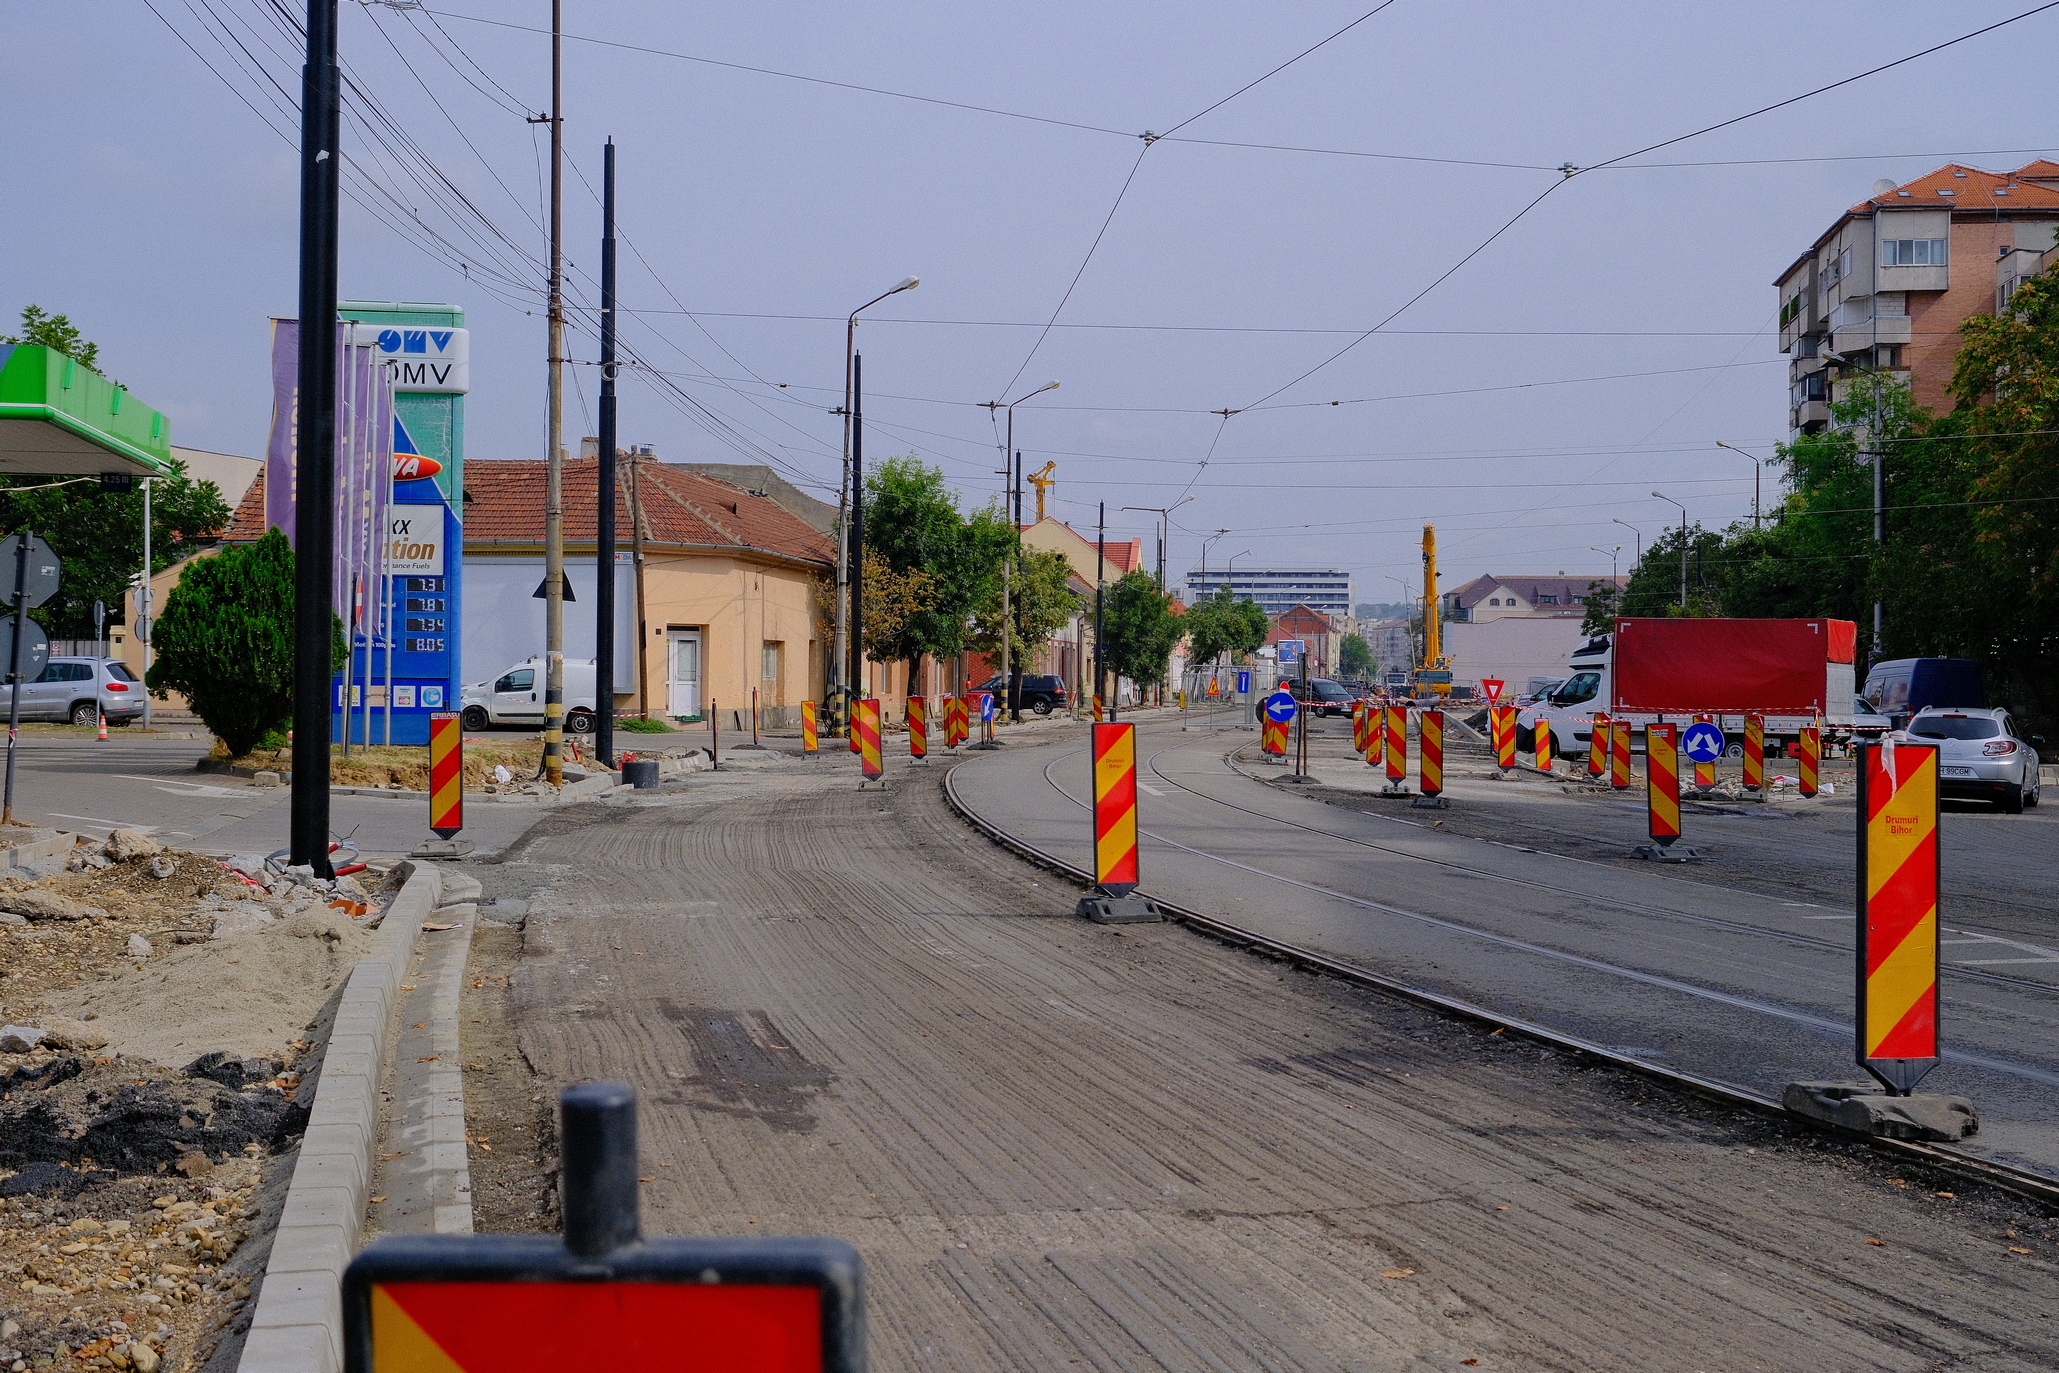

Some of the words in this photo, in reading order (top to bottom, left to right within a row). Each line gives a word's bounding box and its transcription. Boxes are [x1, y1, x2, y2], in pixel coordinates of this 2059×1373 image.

[388, 363, 452, 385] MV
[393, 457, 420, 477] VA
[103, 476, 120, 484] 4.25
[411, 562, 431, 570] Fuels
[418, 598, 445, 612] 7.87
[417, 618, 445, 631] 7.34
[416, 638, 445, 651] 8.05
[1885, 815, 1919, 824] Drumuri
[1890, 825, 1913, 834] Bihor
